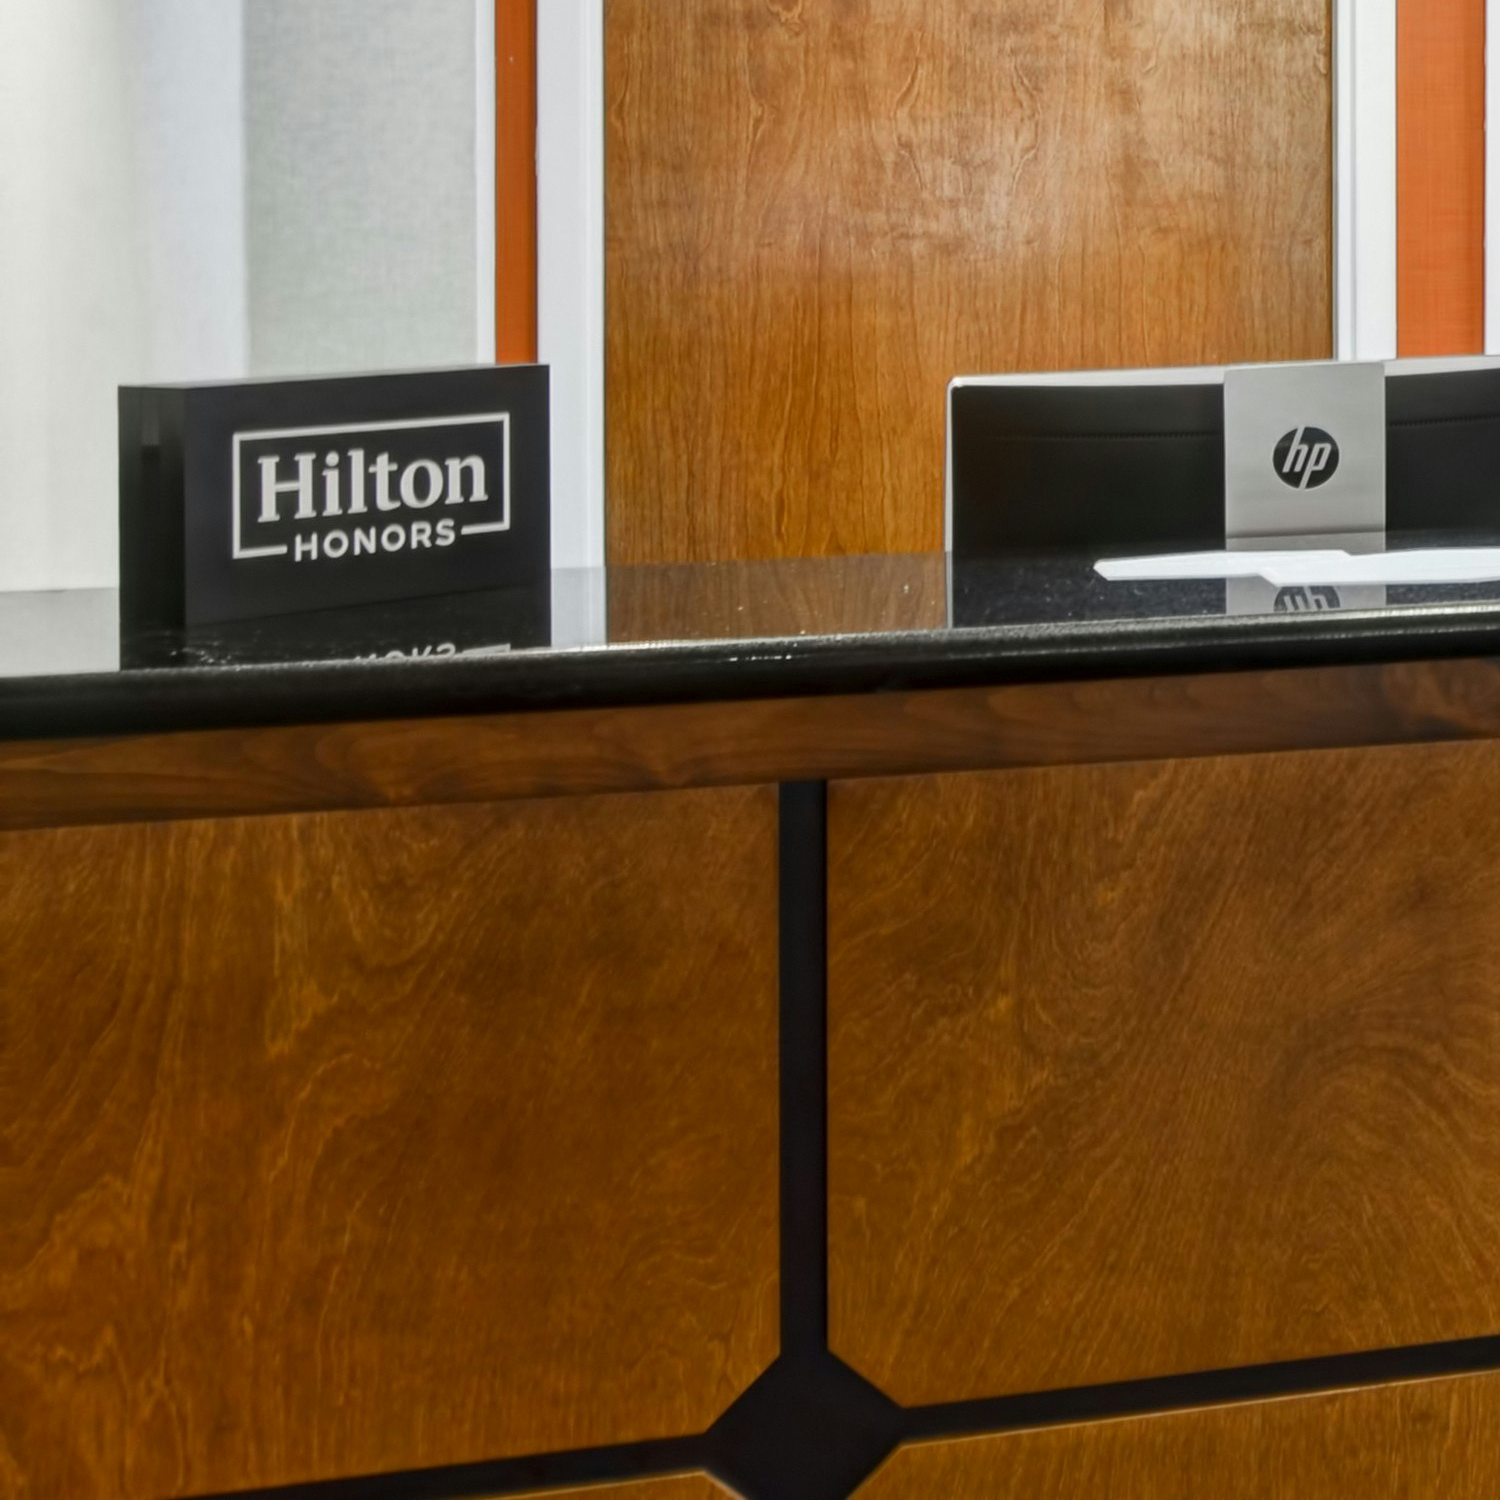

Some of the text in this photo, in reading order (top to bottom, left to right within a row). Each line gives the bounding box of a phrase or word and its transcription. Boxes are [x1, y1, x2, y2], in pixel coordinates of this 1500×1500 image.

[256, 448, 489, 523] Hilton
[1279, 426, 1335, 489] hp
[294, 518, 456, 562] HONORS
